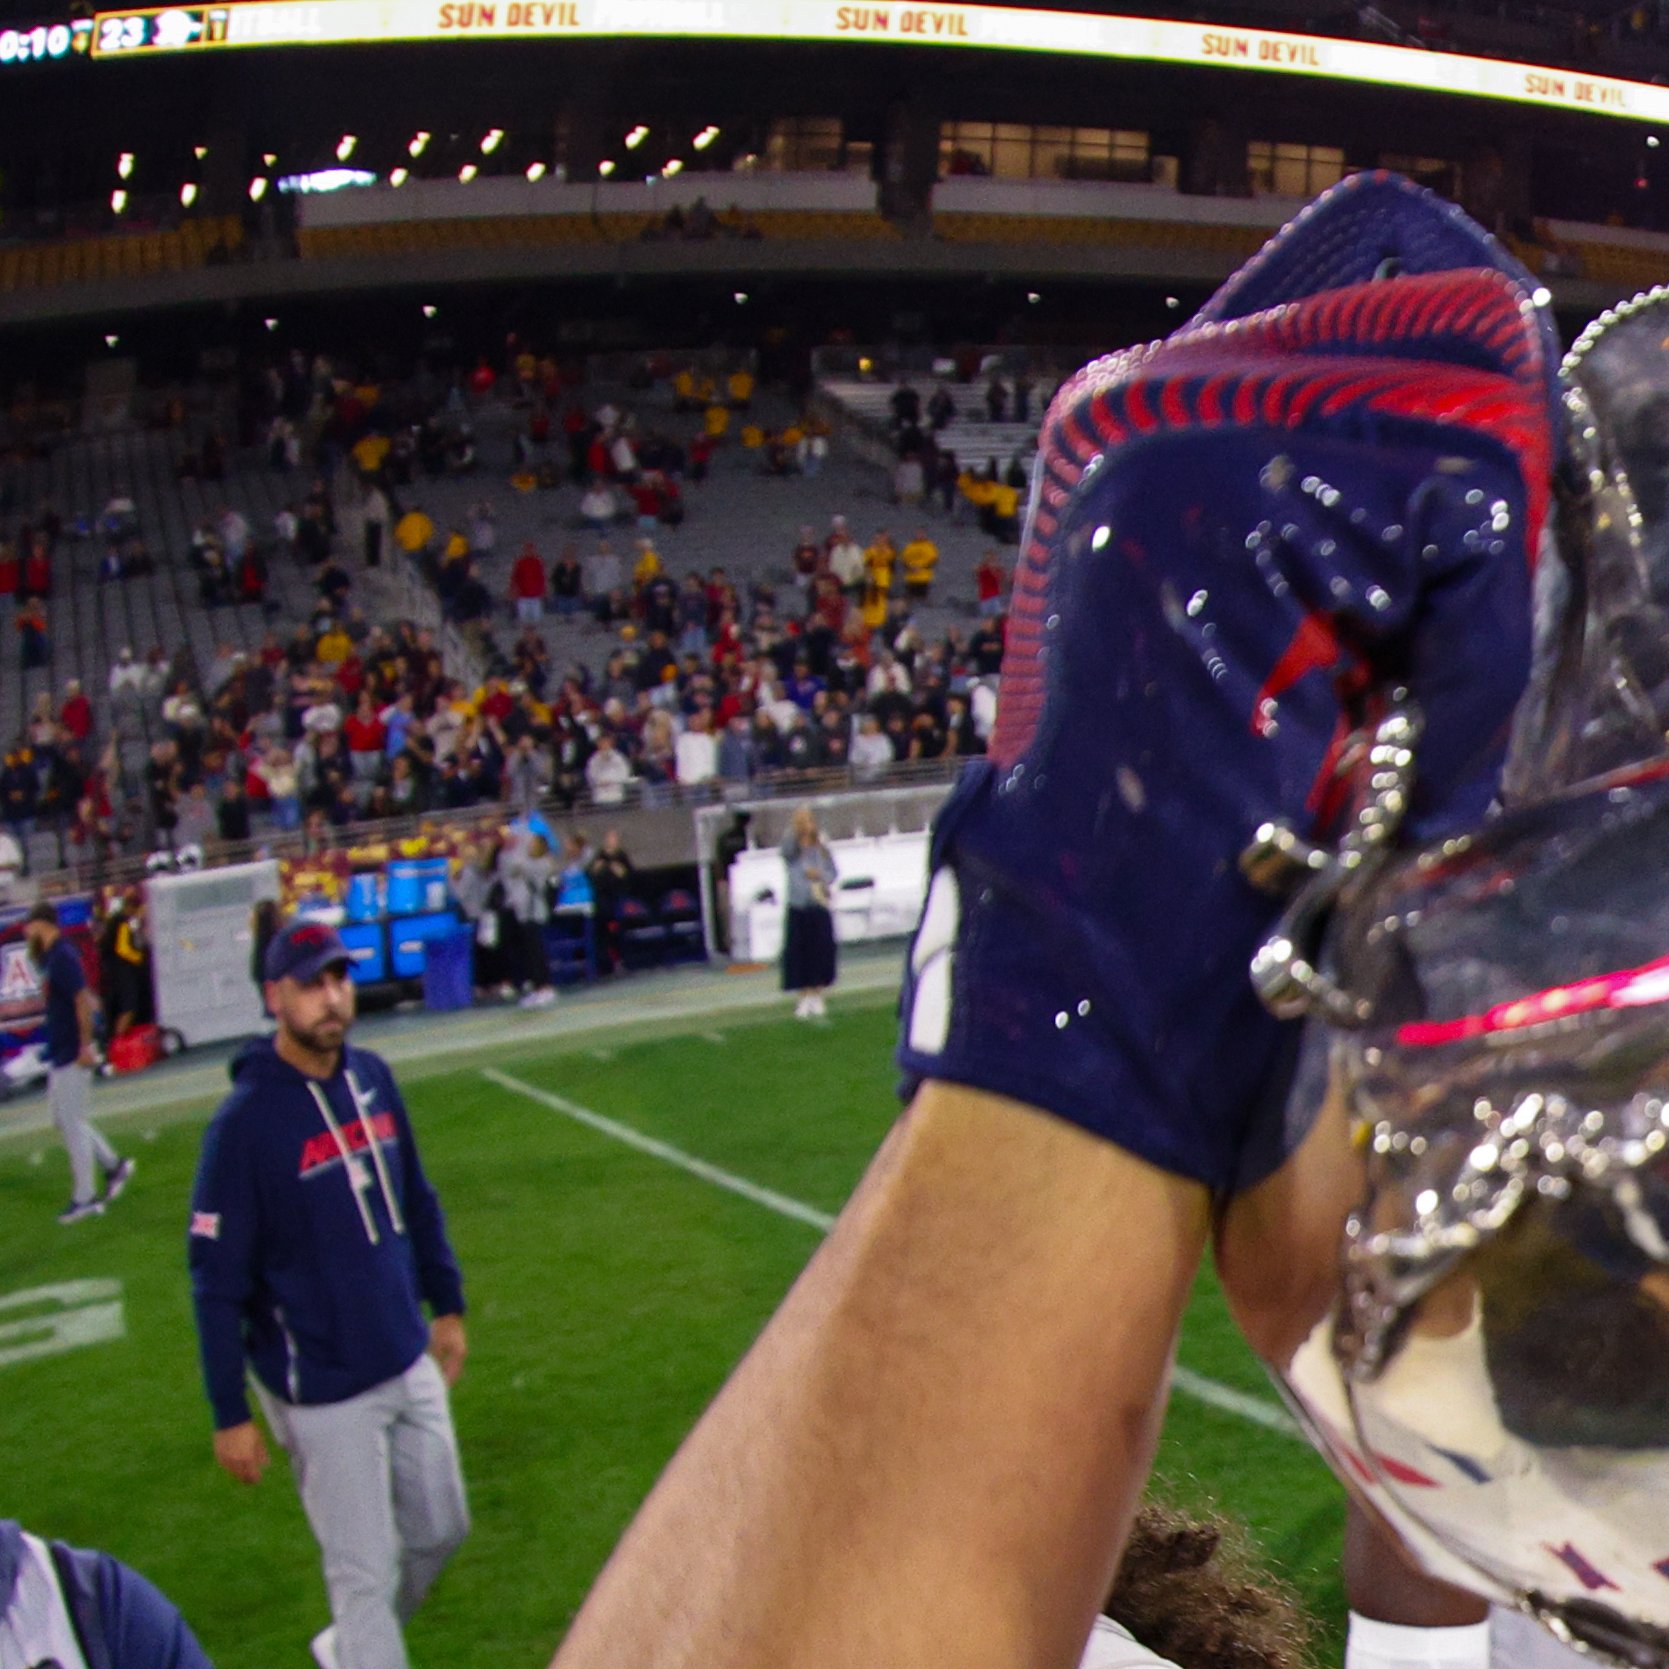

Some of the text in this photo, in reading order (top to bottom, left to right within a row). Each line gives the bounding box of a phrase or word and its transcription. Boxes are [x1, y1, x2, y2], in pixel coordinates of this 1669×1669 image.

[438, 3, 496, 29] SUN
[506, 2, 580, 28] DEVIL
[835, 6, 890, 31] SUN
[900, 10, 969, 37] DEVIL
[100, 16, 145, 50] 23
[1202, 32, 1249, 57] SUN
[1258, 39, 1320, 67] DEVIL
[1524, 73, 1566, 97] SUN
